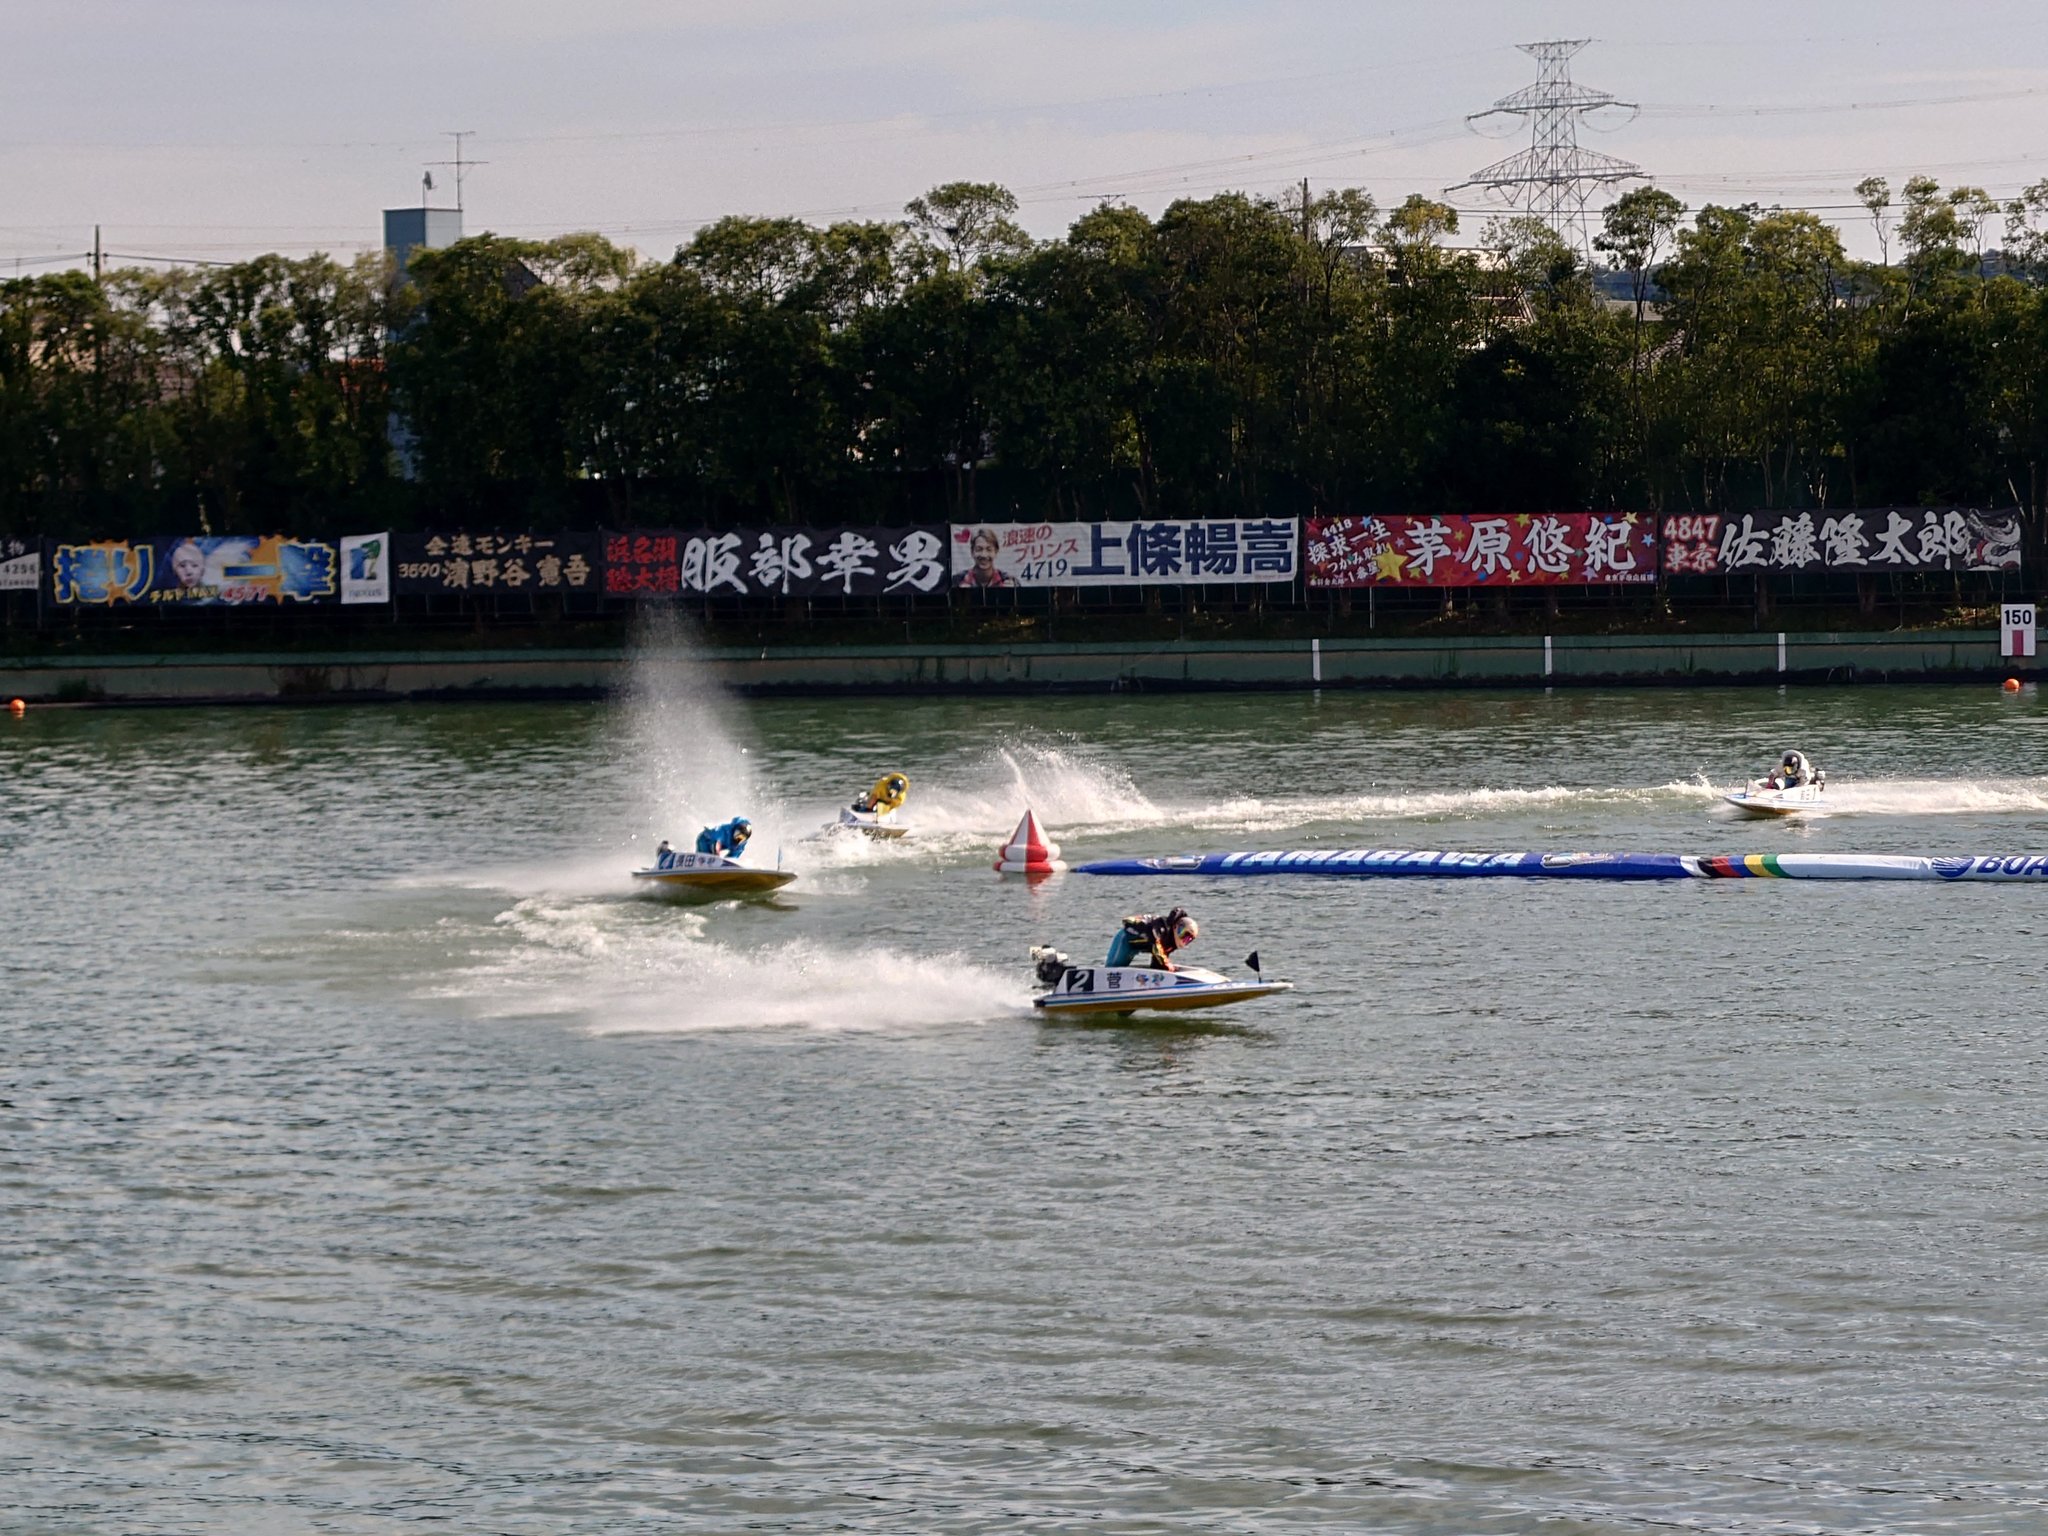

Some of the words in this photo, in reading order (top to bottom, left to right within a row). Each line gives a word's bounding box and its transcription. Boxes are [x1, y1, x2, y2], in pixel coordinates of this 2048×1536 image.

[1002, 524, 1053, 548] 浪速の
[1307, 519, 1392, 565] 探求一生
[1321, 518, 1353, 538] 4418
[1664, 515, 1720, 540] 4847
[1717, 511, 1968, 573] 佐藤隆太郎
[1014, 541, 1079, 564] プリンス
[1071, 522, 1294, 577] 上條暢嵩
[1327, 542, 1389, 573] つかみ取れ
[1405, 516, 1638, 577] 茅原悠紀
[1665, 542, 1719, 574] 東京
[53, 544, 155, 604] 捲り
[681, 530, 947, 595] 服部幸男
[1021, 559, 1068, 581] 4719
[2004, 609, 2032, 625] 150
[1069, 970, 1090, 992] 2
